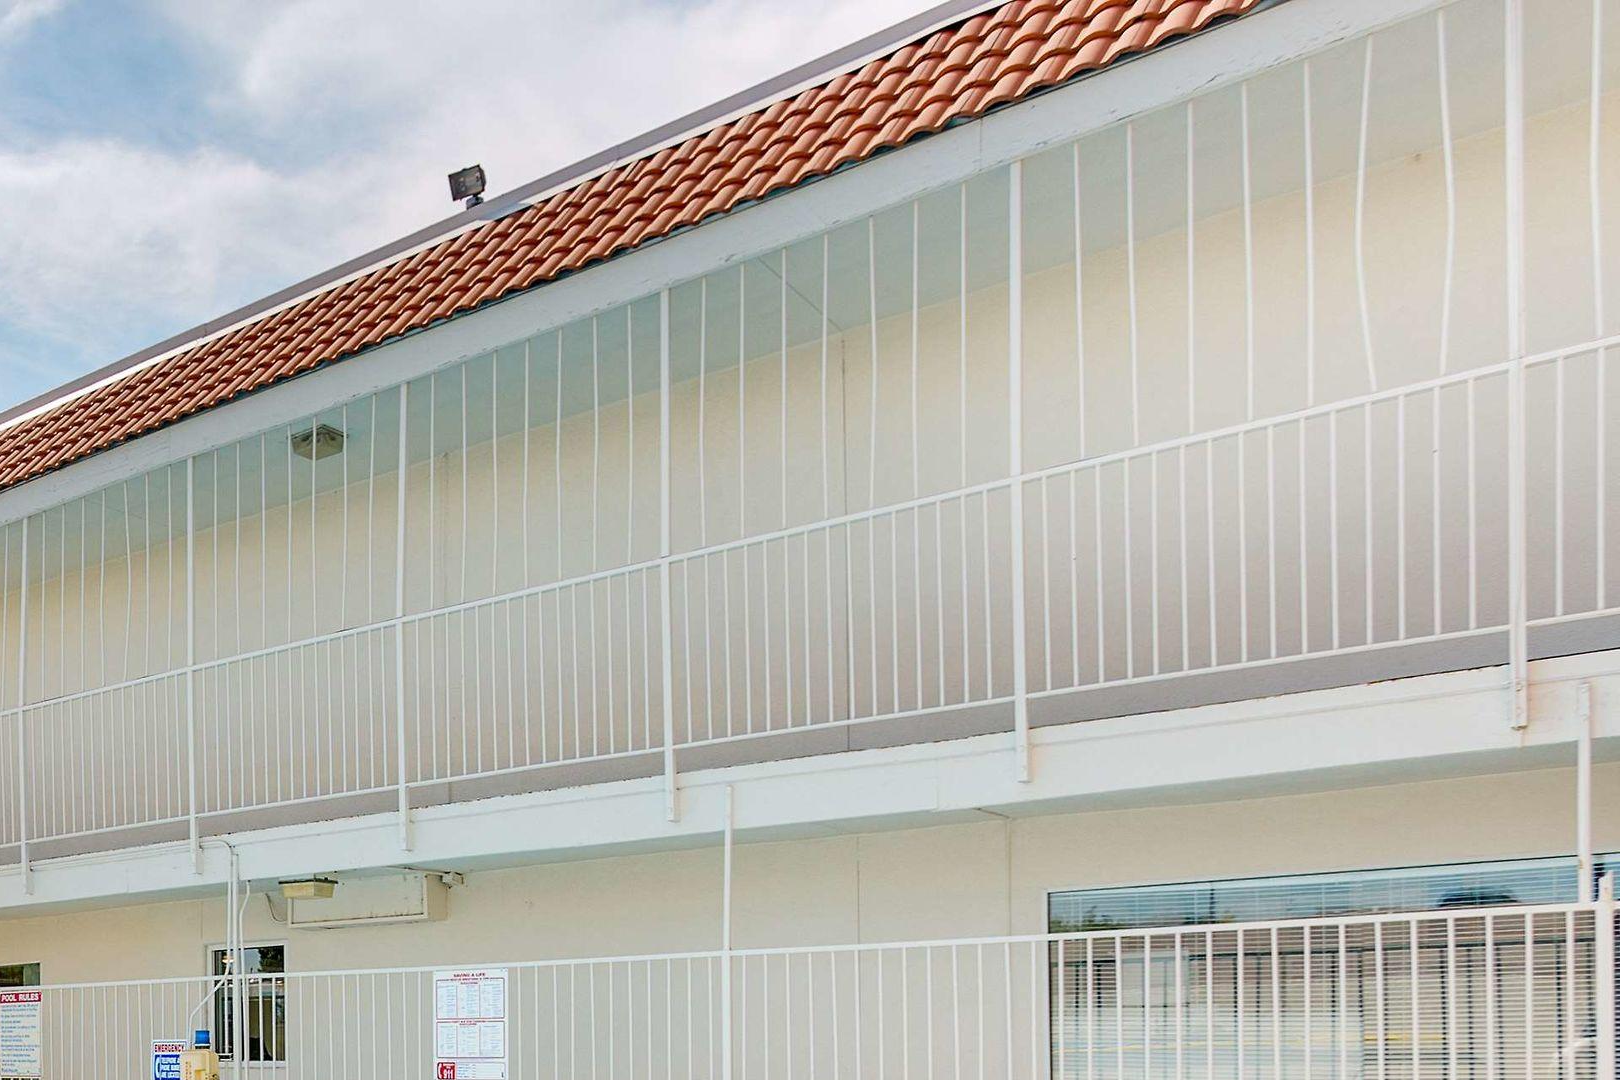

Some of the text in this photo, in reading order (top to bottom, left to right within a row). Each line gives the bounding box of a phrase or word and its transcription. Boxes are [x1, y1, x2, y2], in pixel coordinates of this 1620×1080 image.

[19, 993, 39, 1001] RULES
[154, 1044, 184, 1052] EMERGENCY
[443, 1069, 453, 1079] 911
